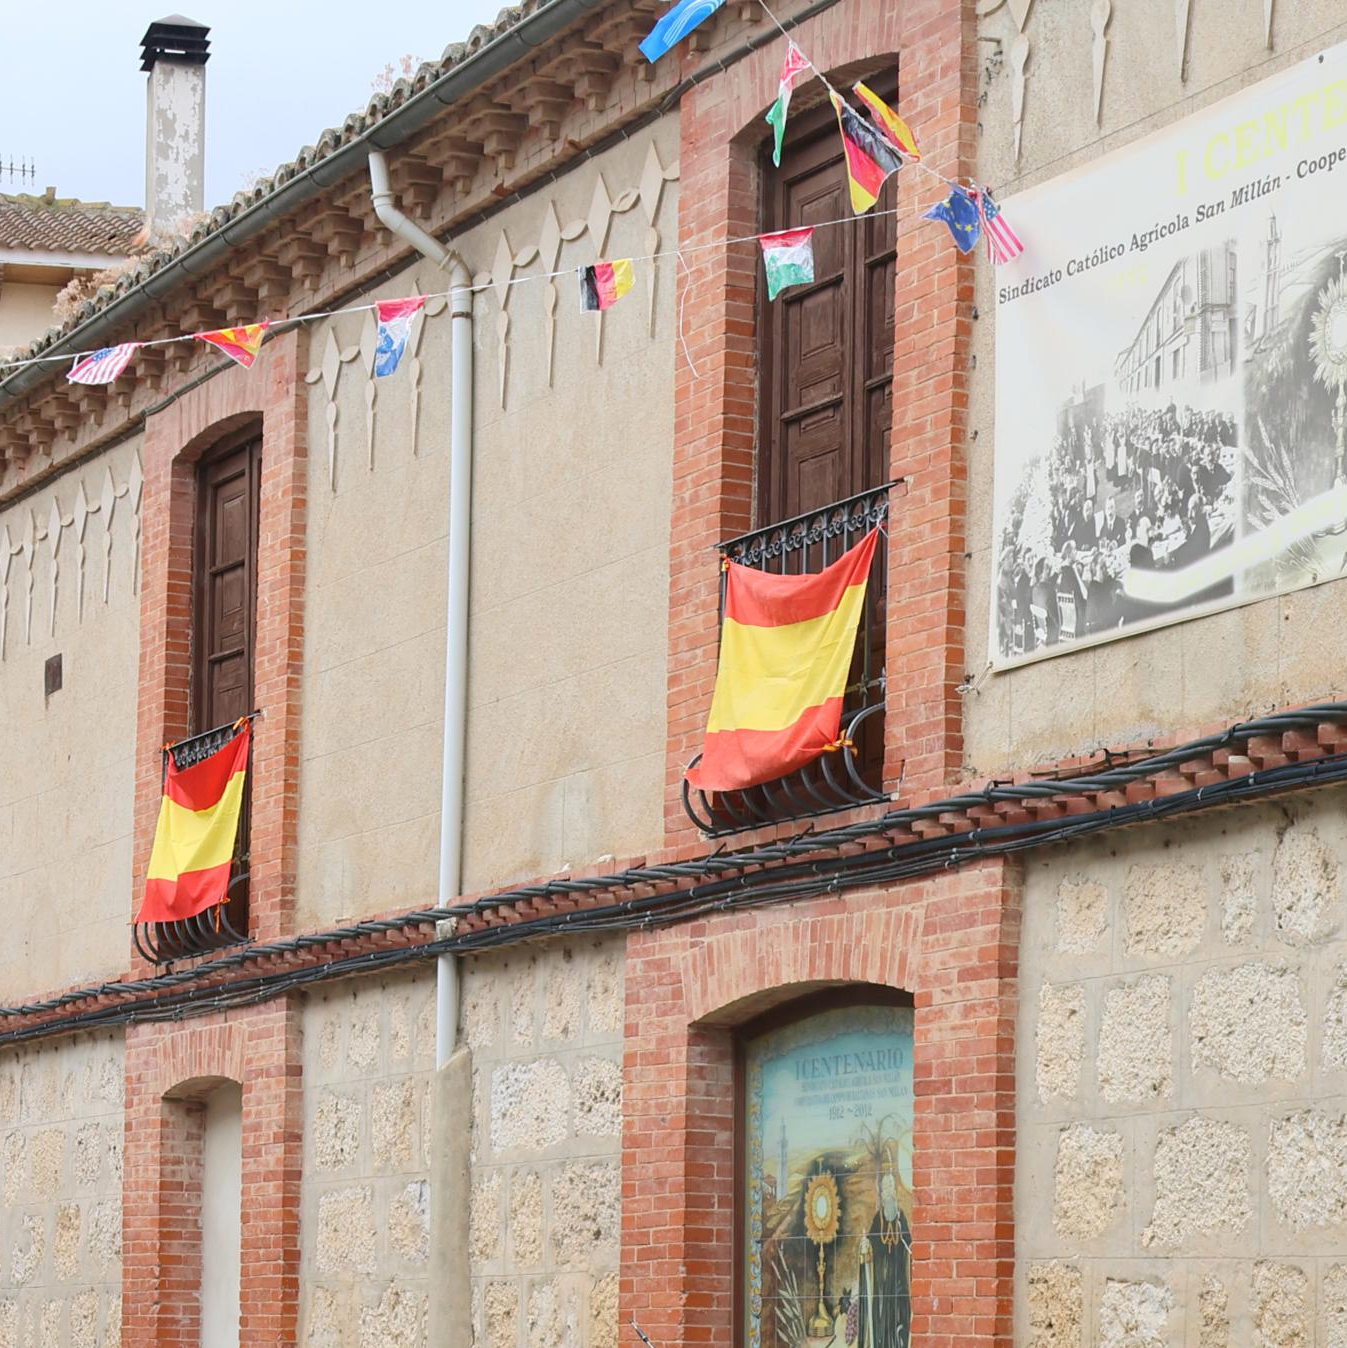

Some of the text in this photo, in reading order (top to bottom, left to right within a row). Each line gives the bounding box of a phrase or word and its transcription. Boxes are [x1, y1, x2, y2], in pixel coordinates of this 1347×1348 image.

[1175, 149, 1195, 196] I
[999, 268, 1063, 304] Sindicato
[1066, 243, 1126, 277] Católico
[1129, 214, 1191, 252] Agrícola
[1195, 200, 1226, 223] San
[1230, 175, 1282, 208] Millán
[801, 1047, 903, 1079] CENTENARIO
